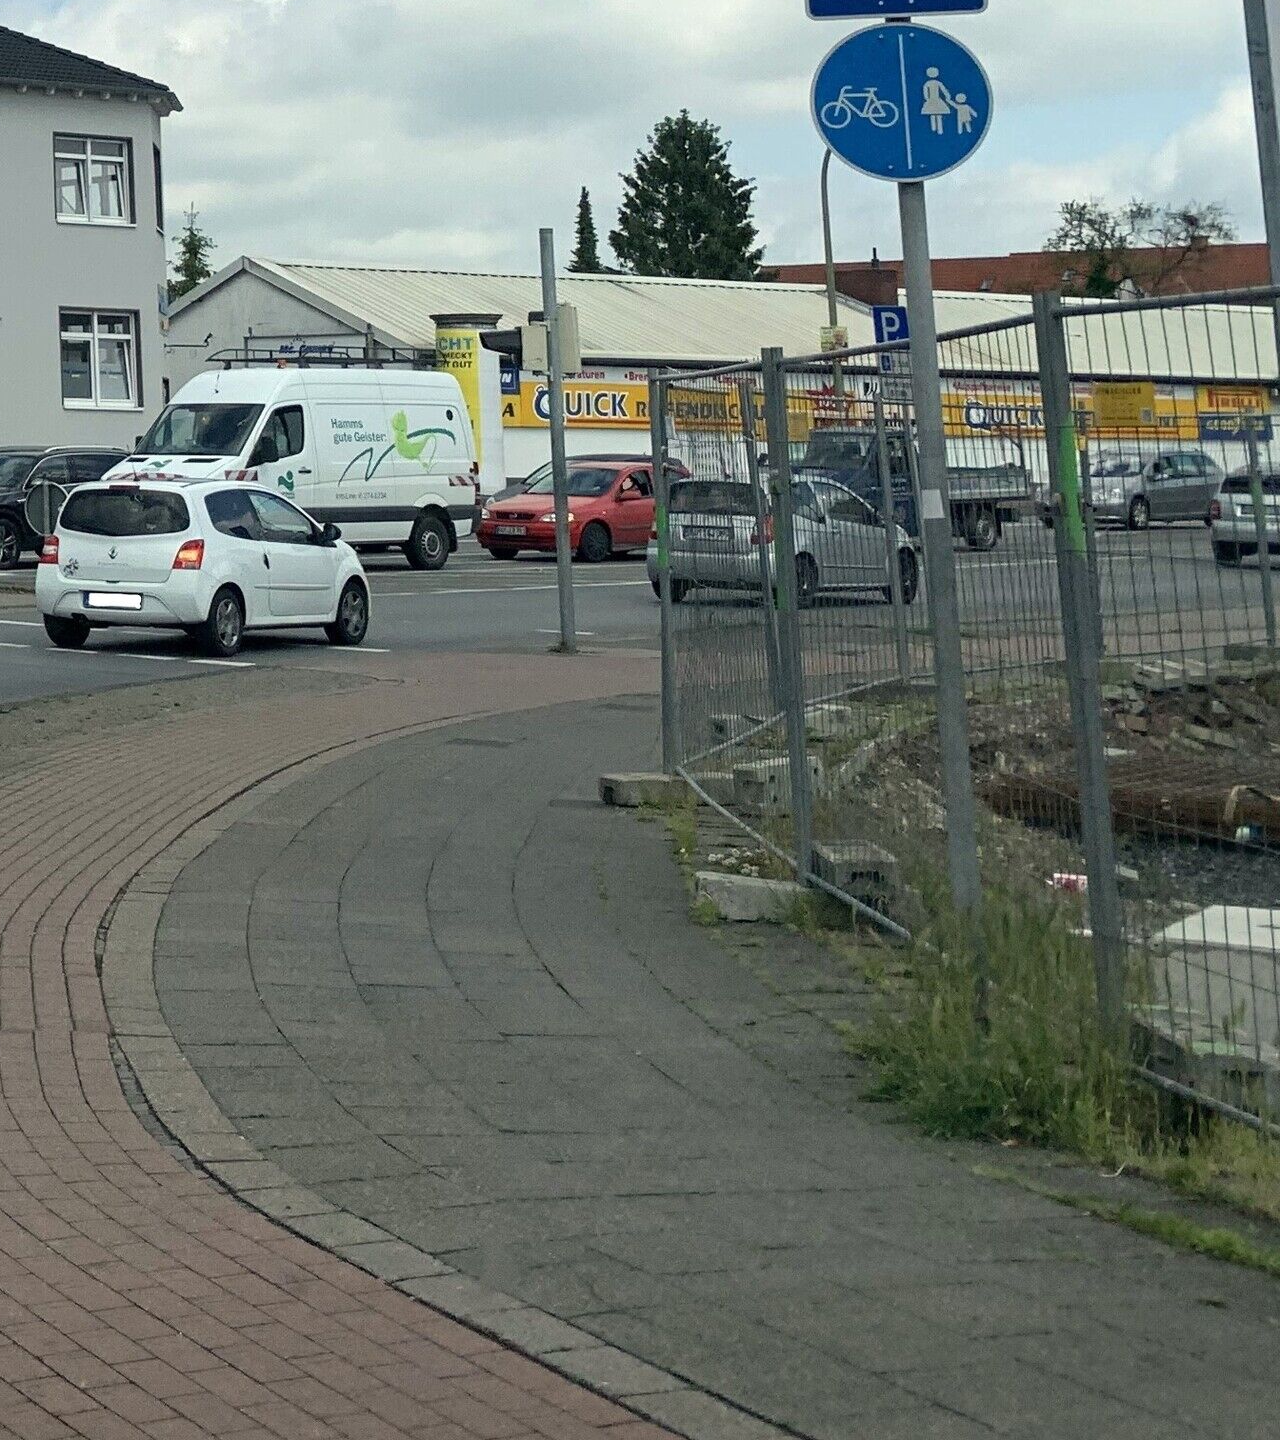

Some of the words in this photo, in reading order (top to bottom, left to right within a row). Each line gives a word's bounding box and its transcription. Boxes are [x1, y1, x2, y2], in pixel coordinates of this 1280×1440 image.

[880, 311, 901, 342] P
[331, 418, 364, 429] Hamms
[333, 432, 352, 445] gute
